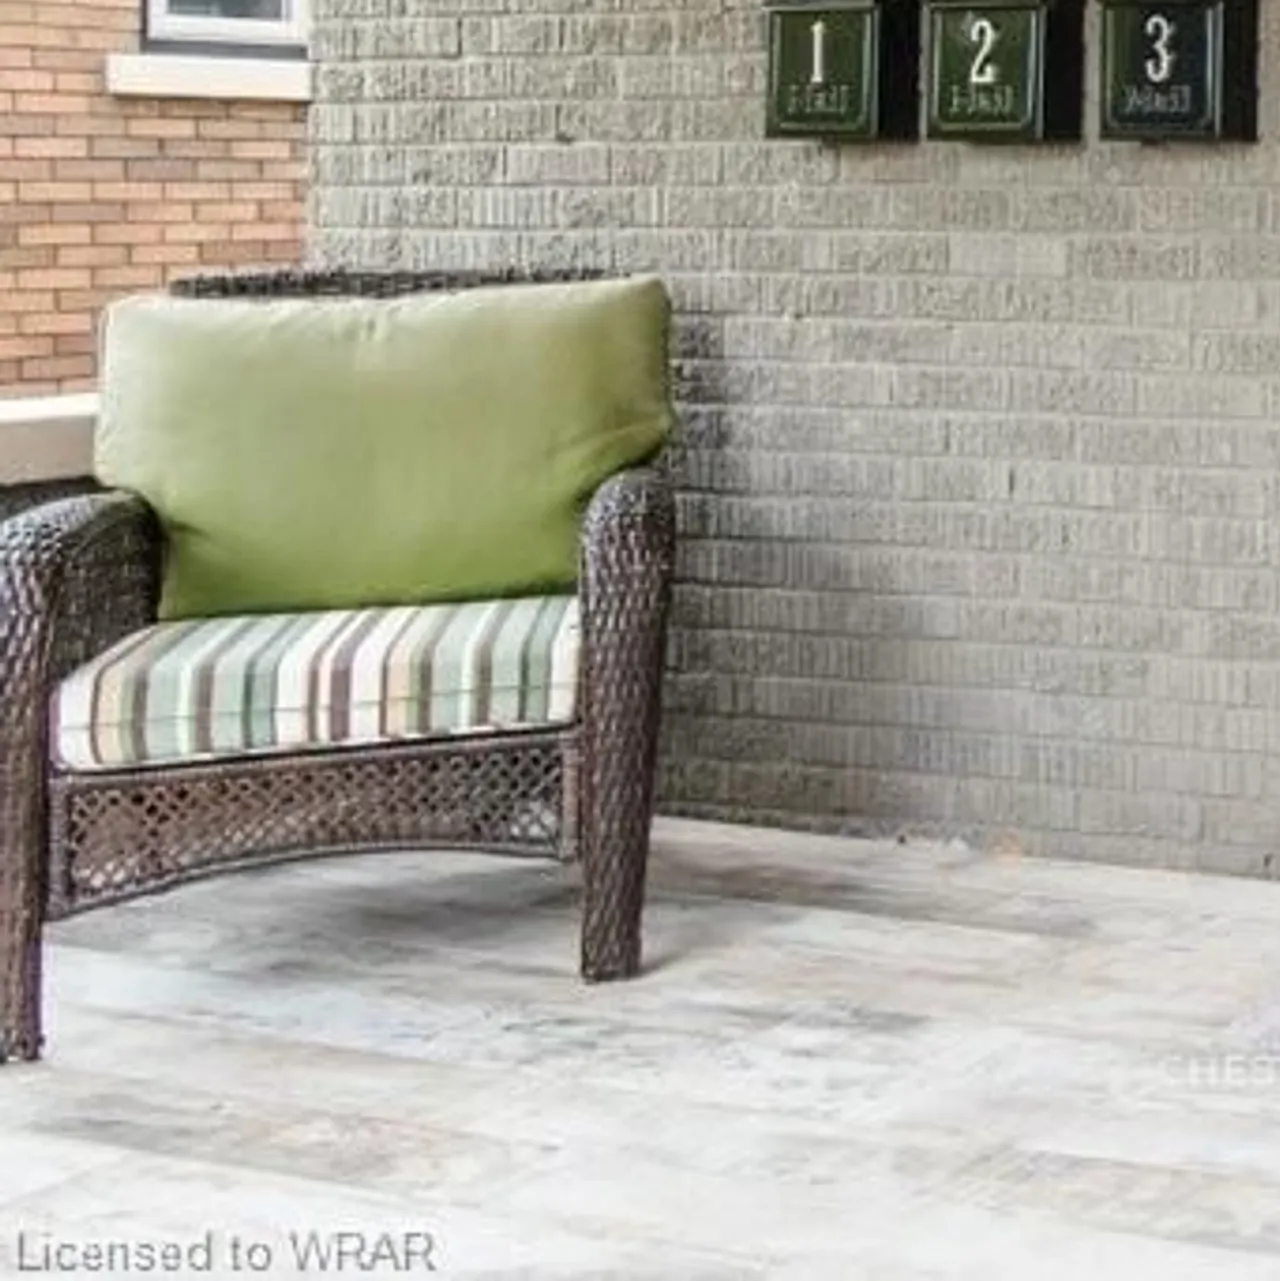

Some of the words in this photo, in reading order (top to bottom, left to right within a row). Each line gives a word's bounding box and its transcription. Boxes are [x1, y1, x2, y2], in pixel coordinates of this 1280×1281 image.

[809, 20, 826, 83] 1
[971, 17, 999, 83] 2
[1145, 13, 1177, 82] 3
